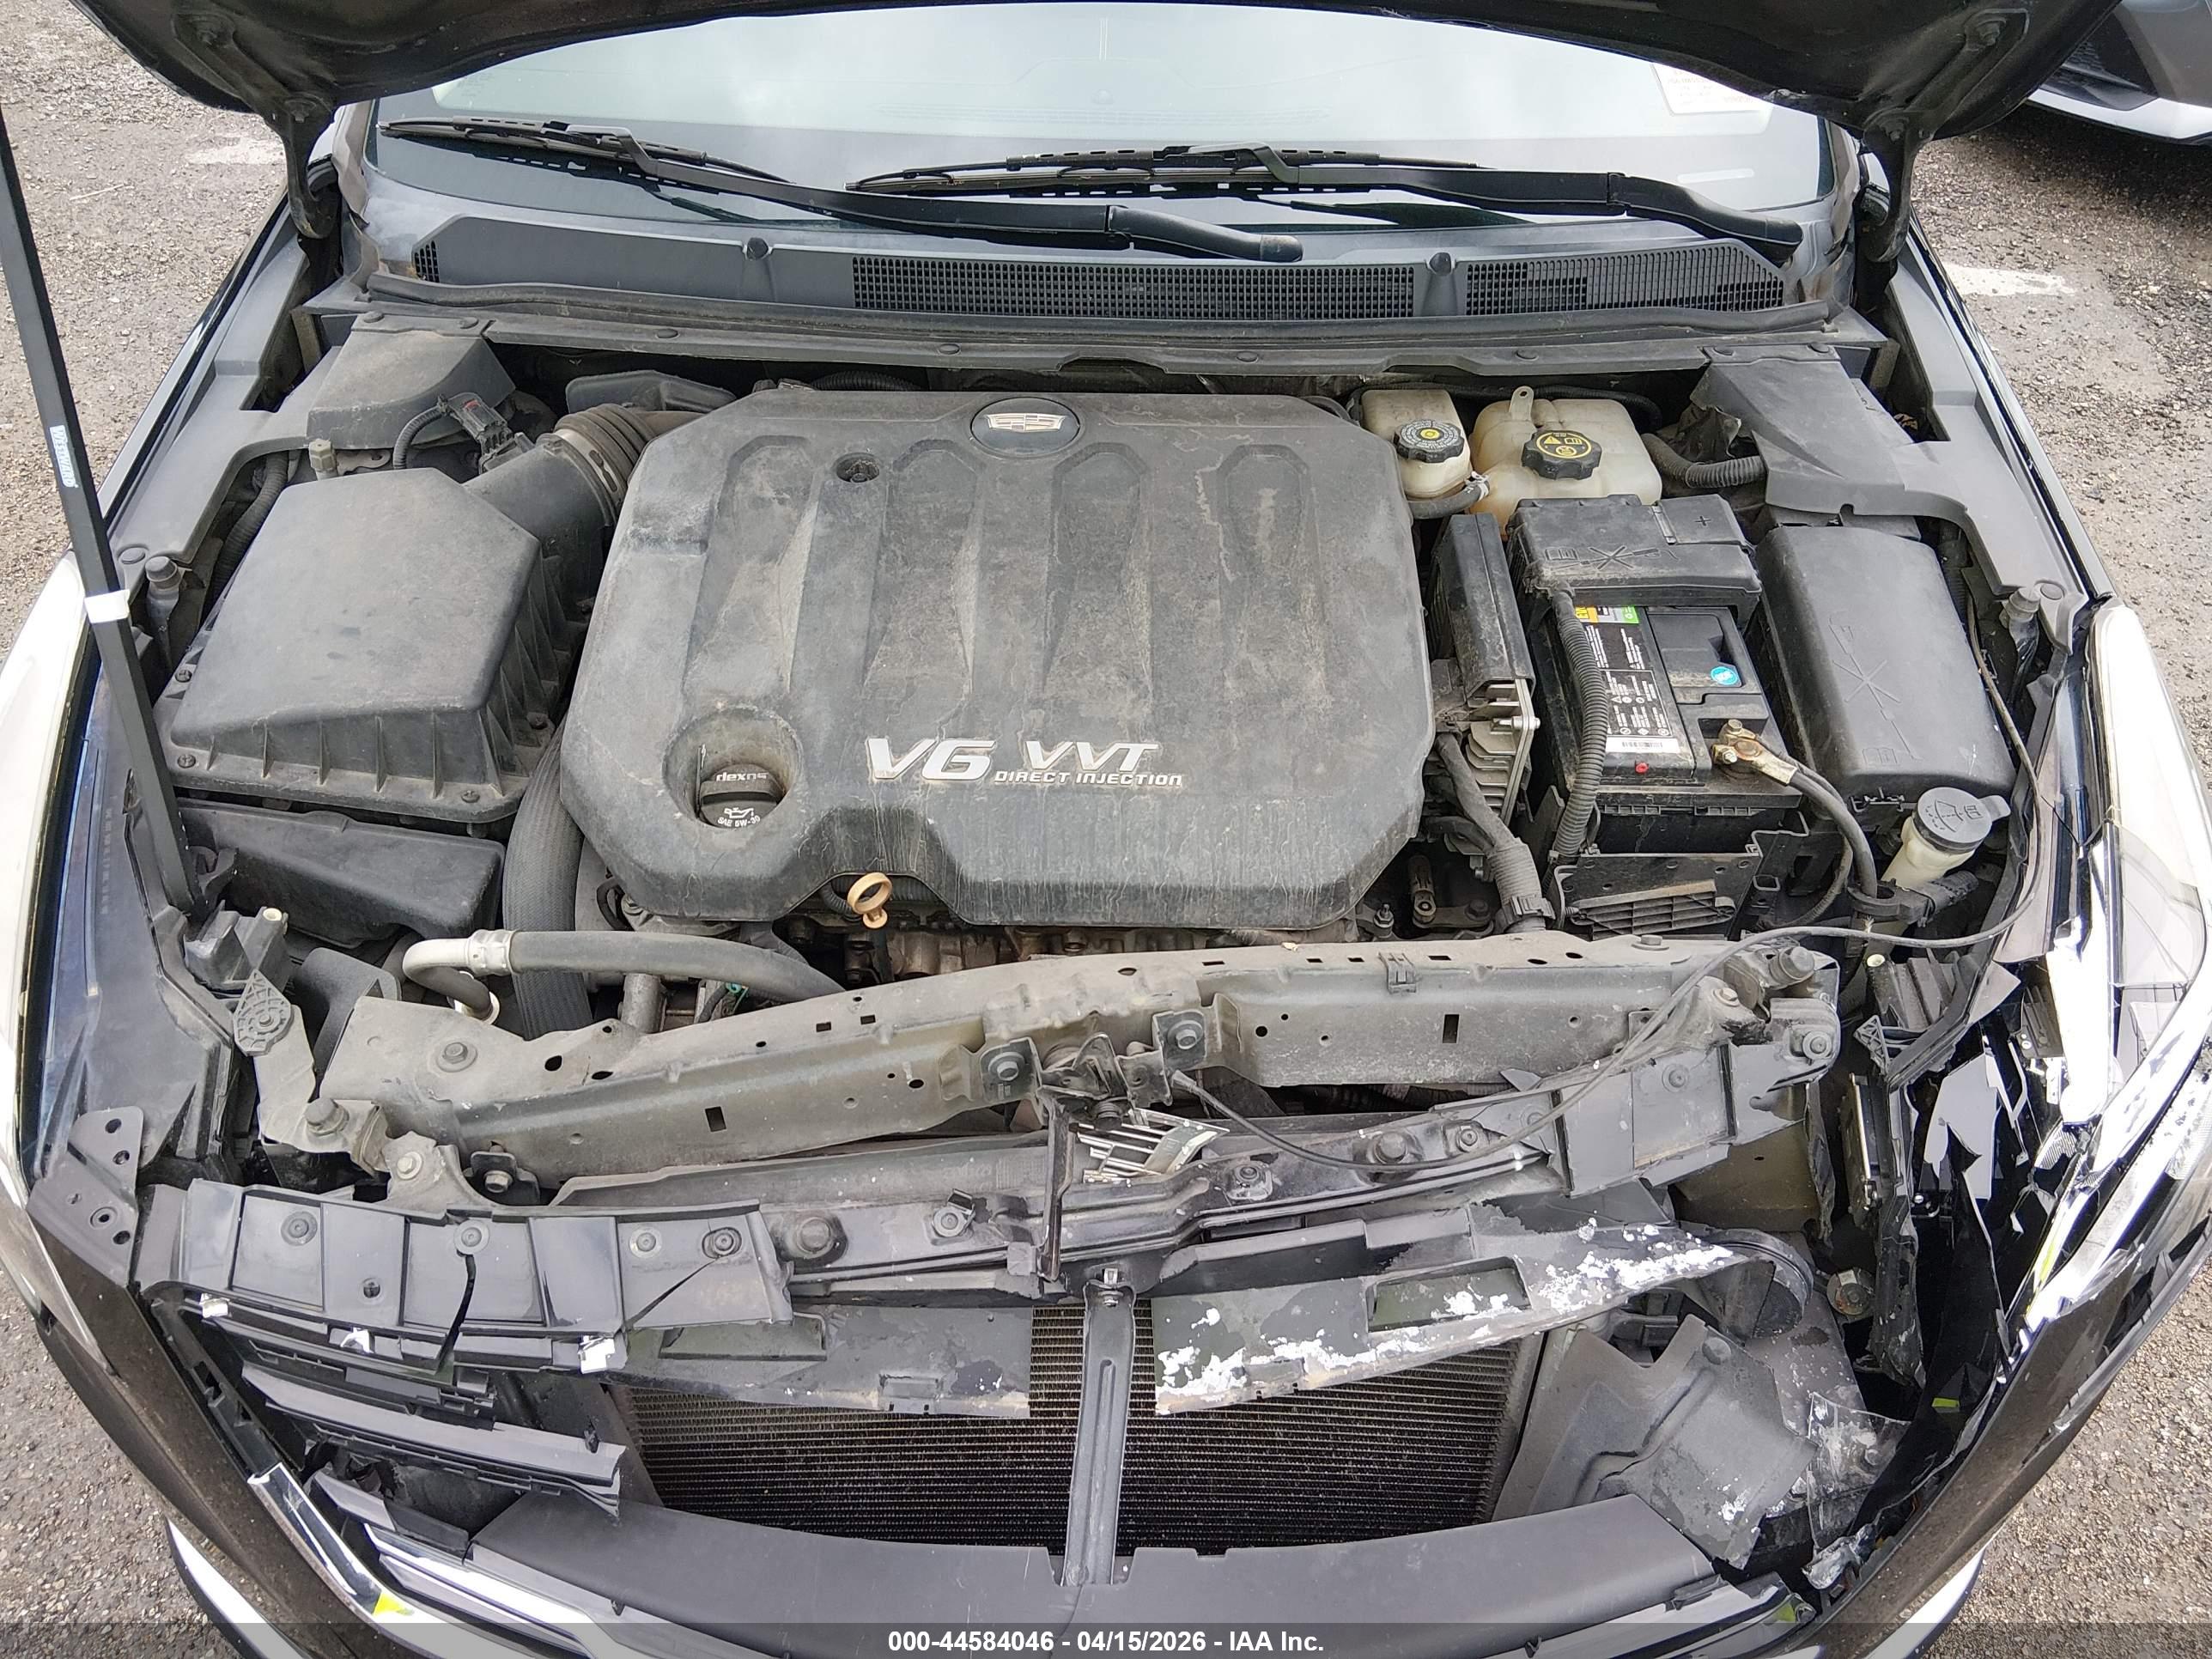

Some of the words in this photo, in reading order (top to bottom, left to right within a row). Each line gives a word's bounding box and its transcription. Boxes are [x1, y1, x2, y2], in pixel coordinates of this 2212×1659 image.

[866, 737, 996, 781] V6
[1024, 739, 1159, 772] VVT
[994, 770, 1070, 783] DIRECT
[1075, 773, 1182, 786] INJECTION
[717, 817, 733, 827] SAE
[734, 815, 761, 827] 5W-30
